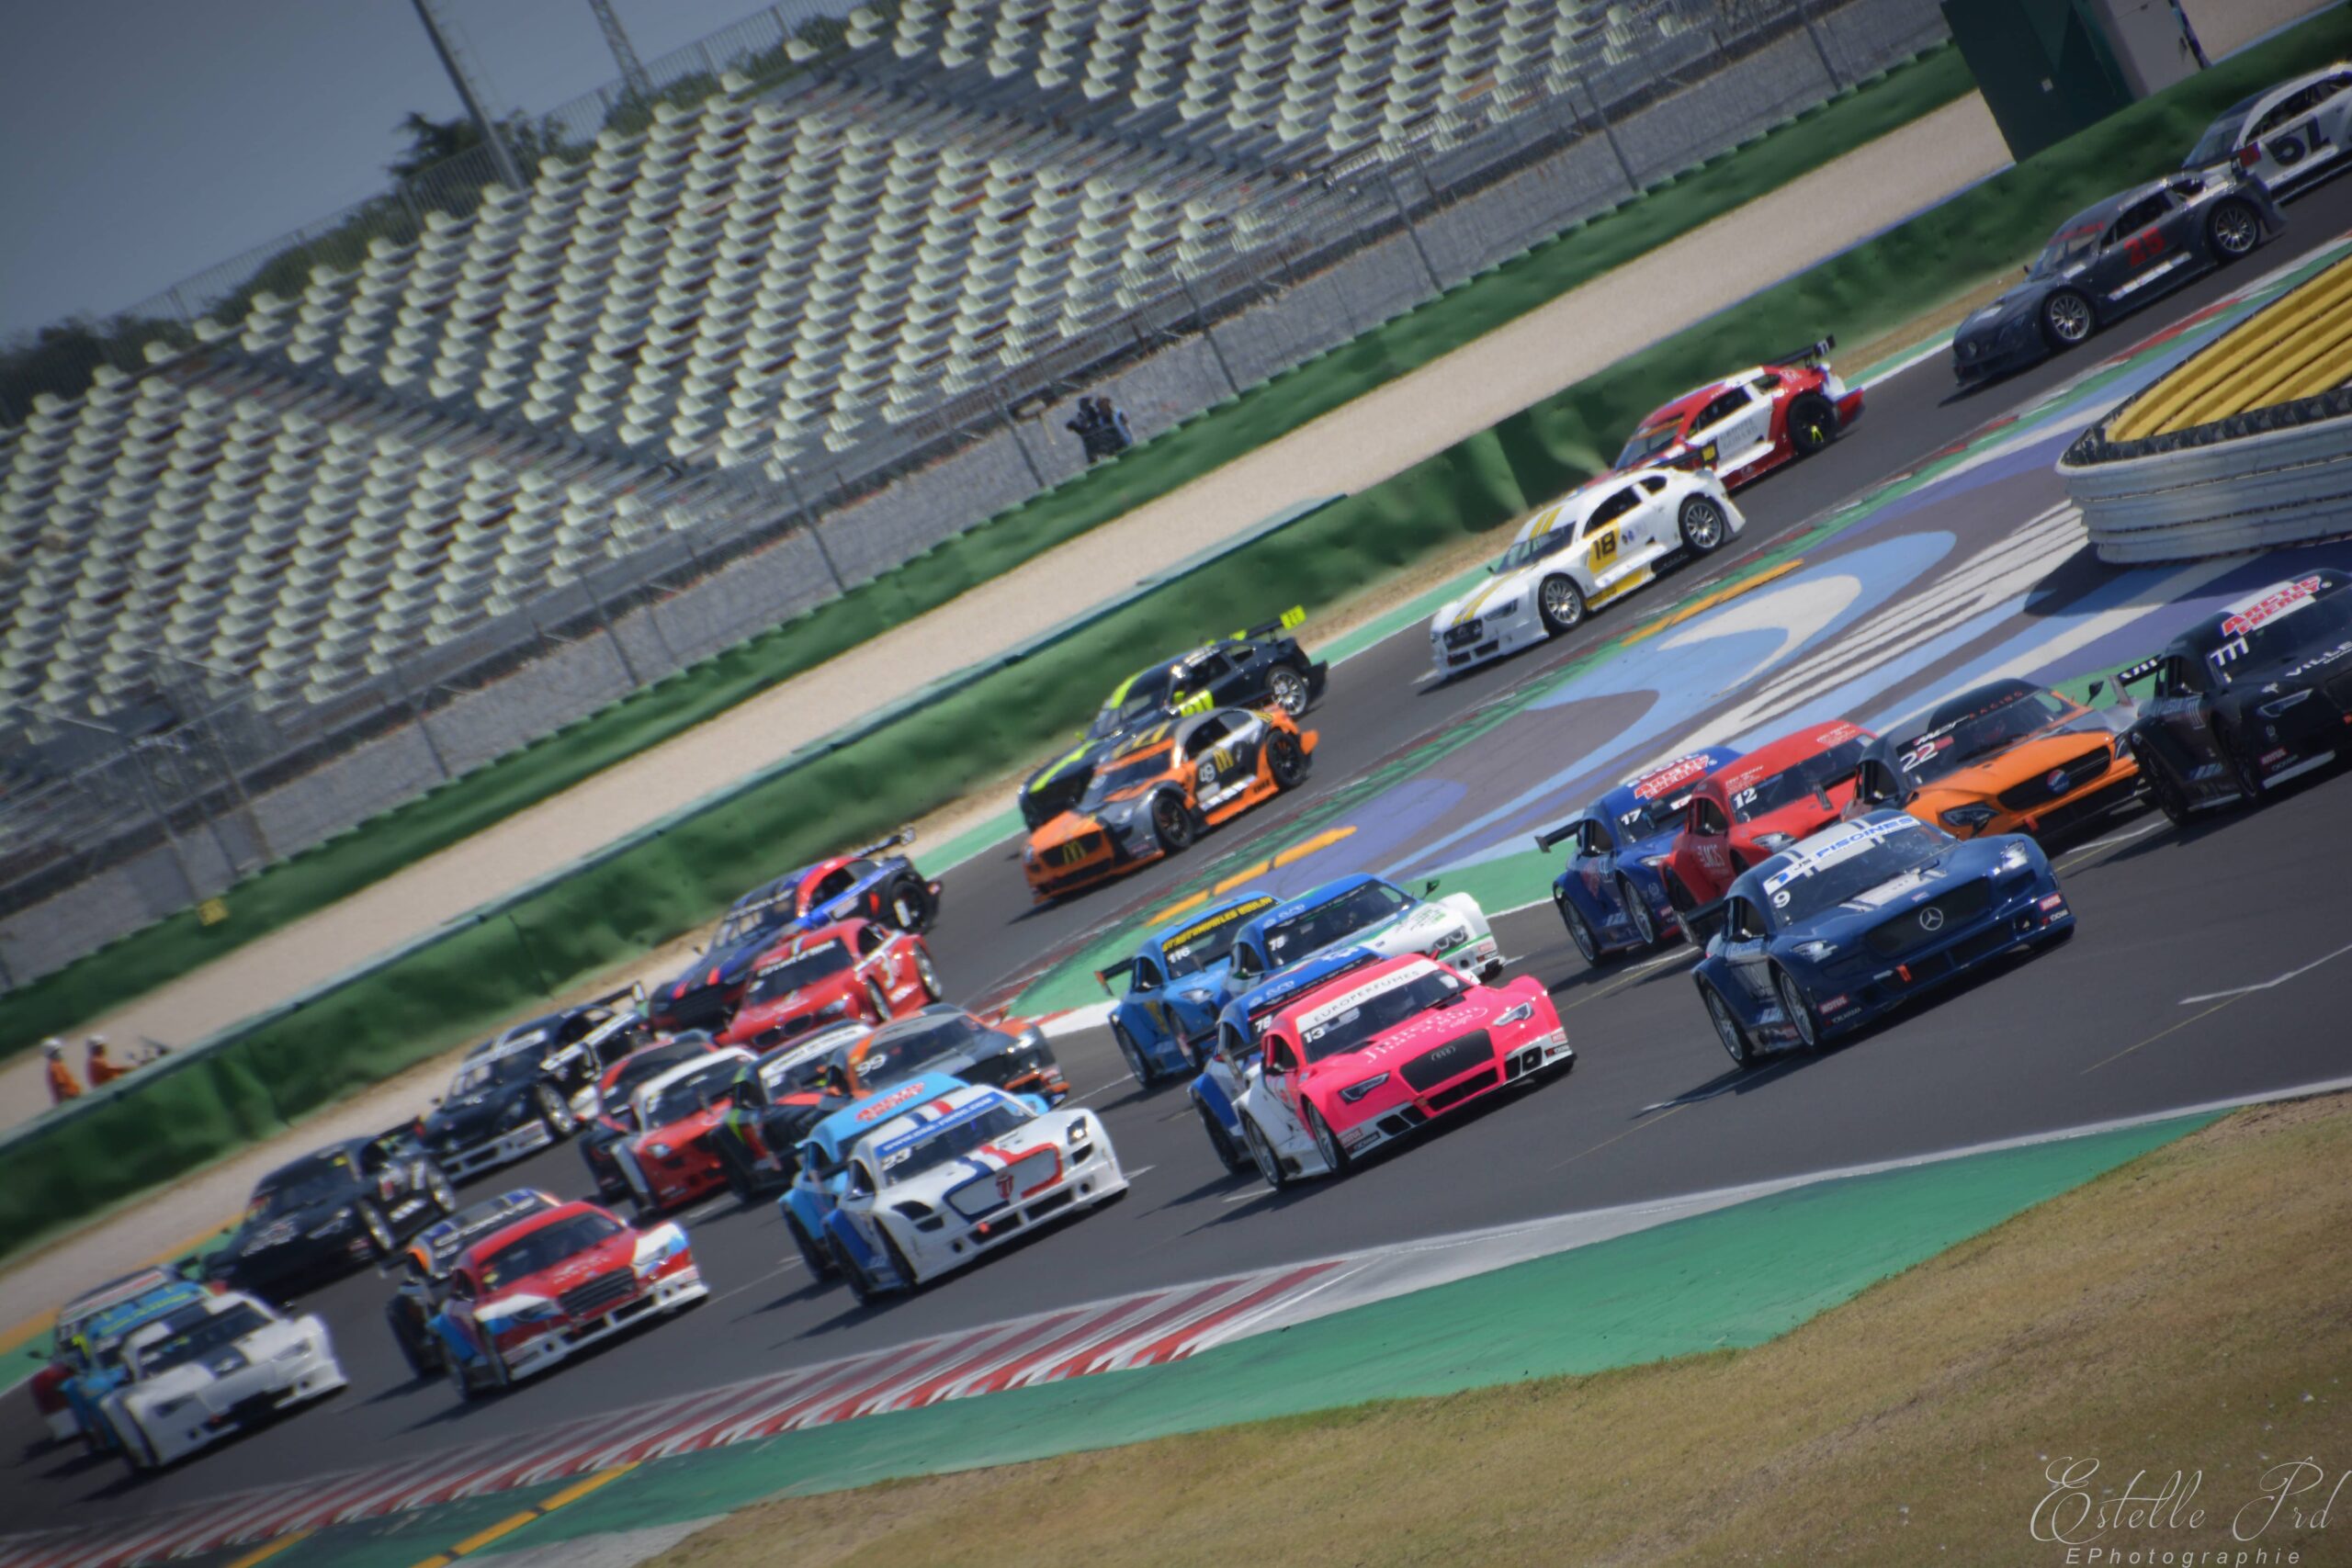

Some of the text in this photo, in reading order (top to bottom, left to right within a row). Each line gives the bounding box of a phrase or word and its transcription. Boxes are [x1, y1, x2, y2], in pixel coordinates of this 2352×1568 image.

[2123, 227, 2166, 267] 25
[1592, 529, 1618, 562] 18
[2222, 575, 2322, 637] ARCTIC
[1900, 742, 1939, 773] 22
[1734, 787, 1758, 809] 12
[1621, 808, 1642, 826] 17
[1773, 891, 1791, 908] 9
[1820, 996, 1848, 1013] MOTUL
[1304, 1027, 1326, 1043] 13
[856, 1055, 888, 1077] 99
